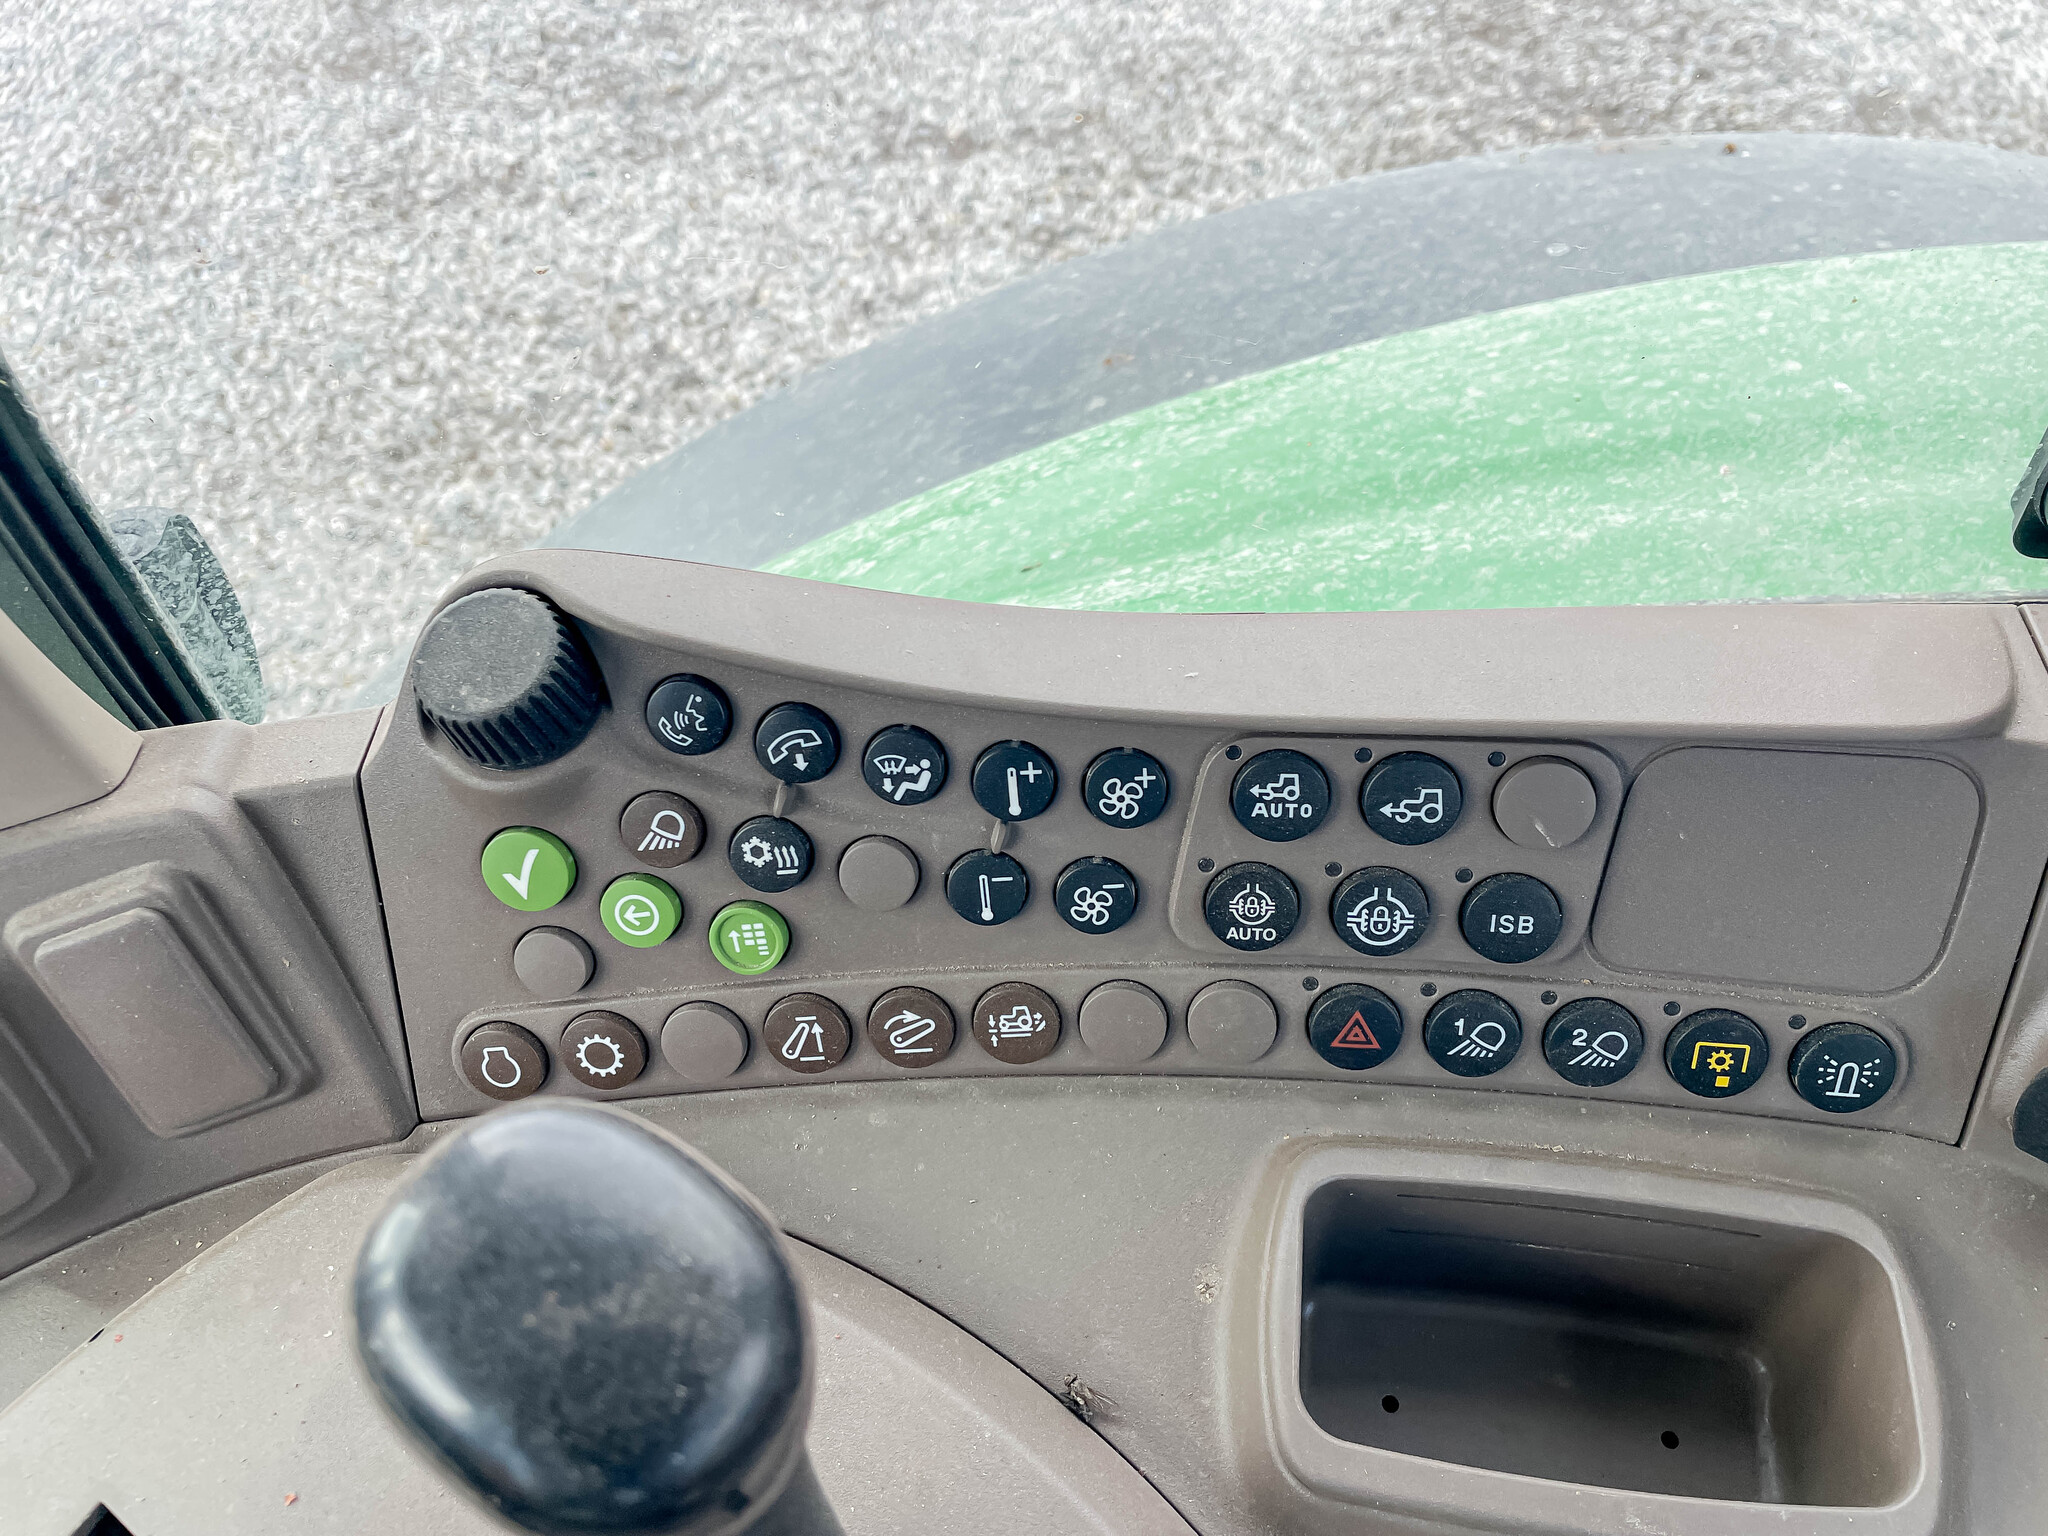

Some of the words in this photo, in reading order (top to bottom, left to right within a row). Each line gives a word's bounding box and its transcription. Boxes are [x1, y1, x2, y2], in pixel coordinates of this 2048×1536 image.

[1250, 803, 1313, 818] AUTO
[1489, 914, 1535, 935] ISB
[1226, 927, 1277, 942] AUTO
[1454, 1018, 1466, 1037] 1
[1572, 1028, 1586, 1045] 2
